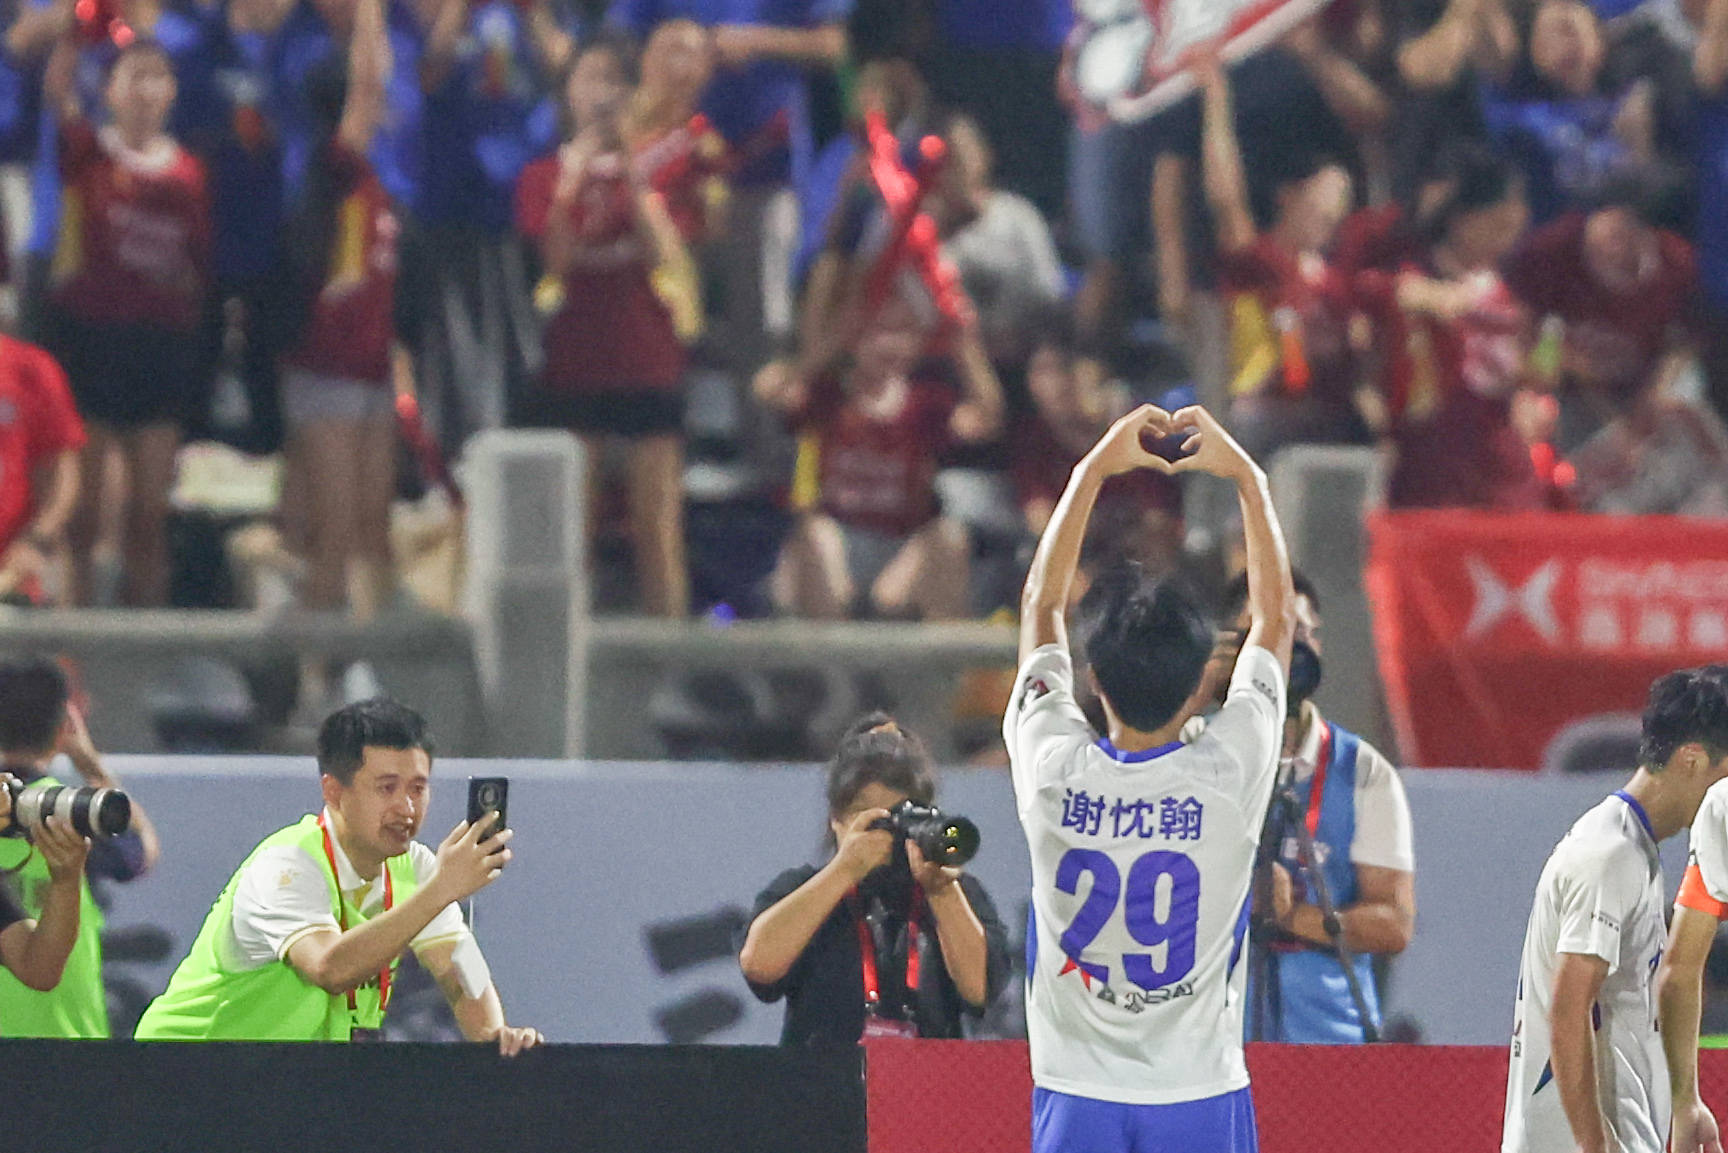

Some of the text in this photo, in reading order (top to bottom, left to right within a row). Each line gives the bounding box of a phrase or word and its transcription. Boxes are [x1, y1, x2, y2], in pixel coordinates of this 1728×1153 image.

[1061, 788, 1204, 841] 谢忱翰
[1055, 848, 1201, 991] 29
